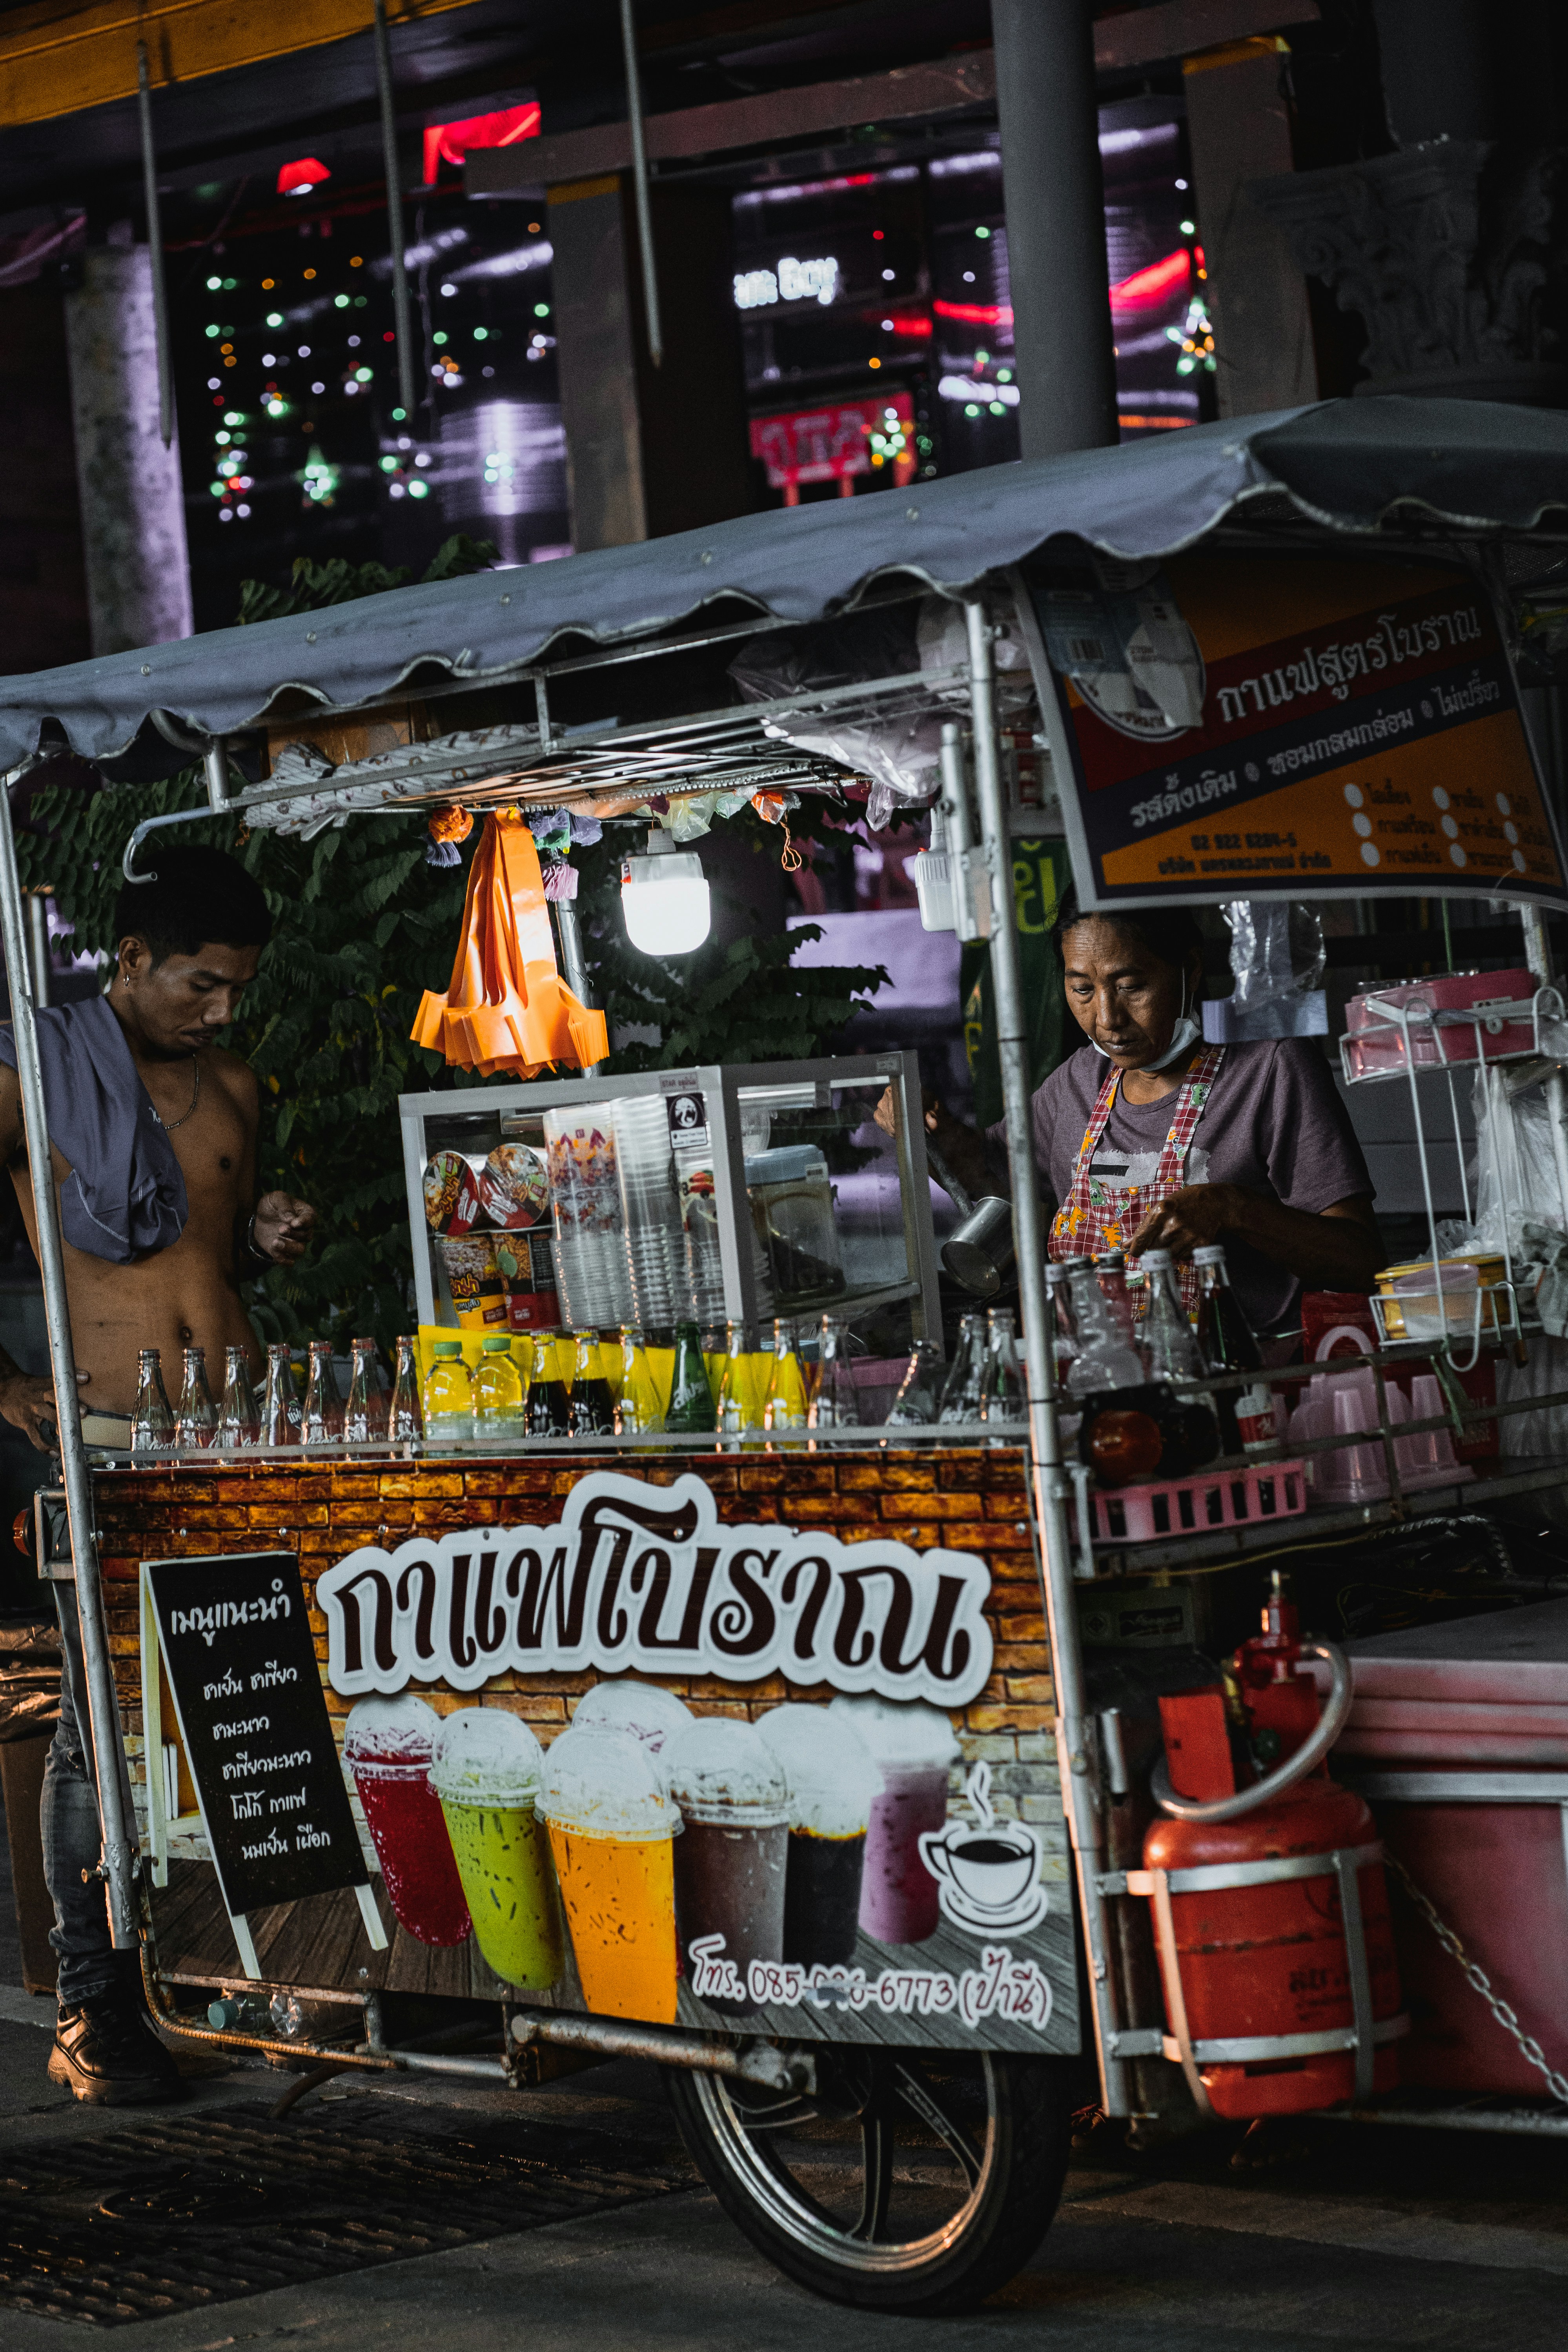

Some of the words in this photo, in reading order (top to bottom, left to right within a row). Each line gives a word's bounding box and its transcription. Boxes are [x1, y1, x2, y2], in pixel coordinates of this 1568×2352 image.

[1215, 605, 1482, 723] กาแฟสูตรโบราณ
[1130, 768, 1237, 826] รสดั้งเดิม
[332, 1495, 970, 1680] กาแฟโบราณ
[171, 1578, 290, 1647] เมนูแนะนำ
[203, 1668, 243, 1701] ชาเย็น
[250, 1660, 298, 1691] ชาเขียว
[212, 1715, 270, 1741] ชามะนาว
[222, 1748, 312, 1781] ชาเขียวมะนาว
[230, 1789, 265, 1820] โกโก้
[270, 1787, 307, 1814] กาแฟ
[242, 1827, 288, 1860] นมเย็น
[296, 1823, 331, 1851] เผือก
[962, 1952, 1049, 2024] (ป้านี)
